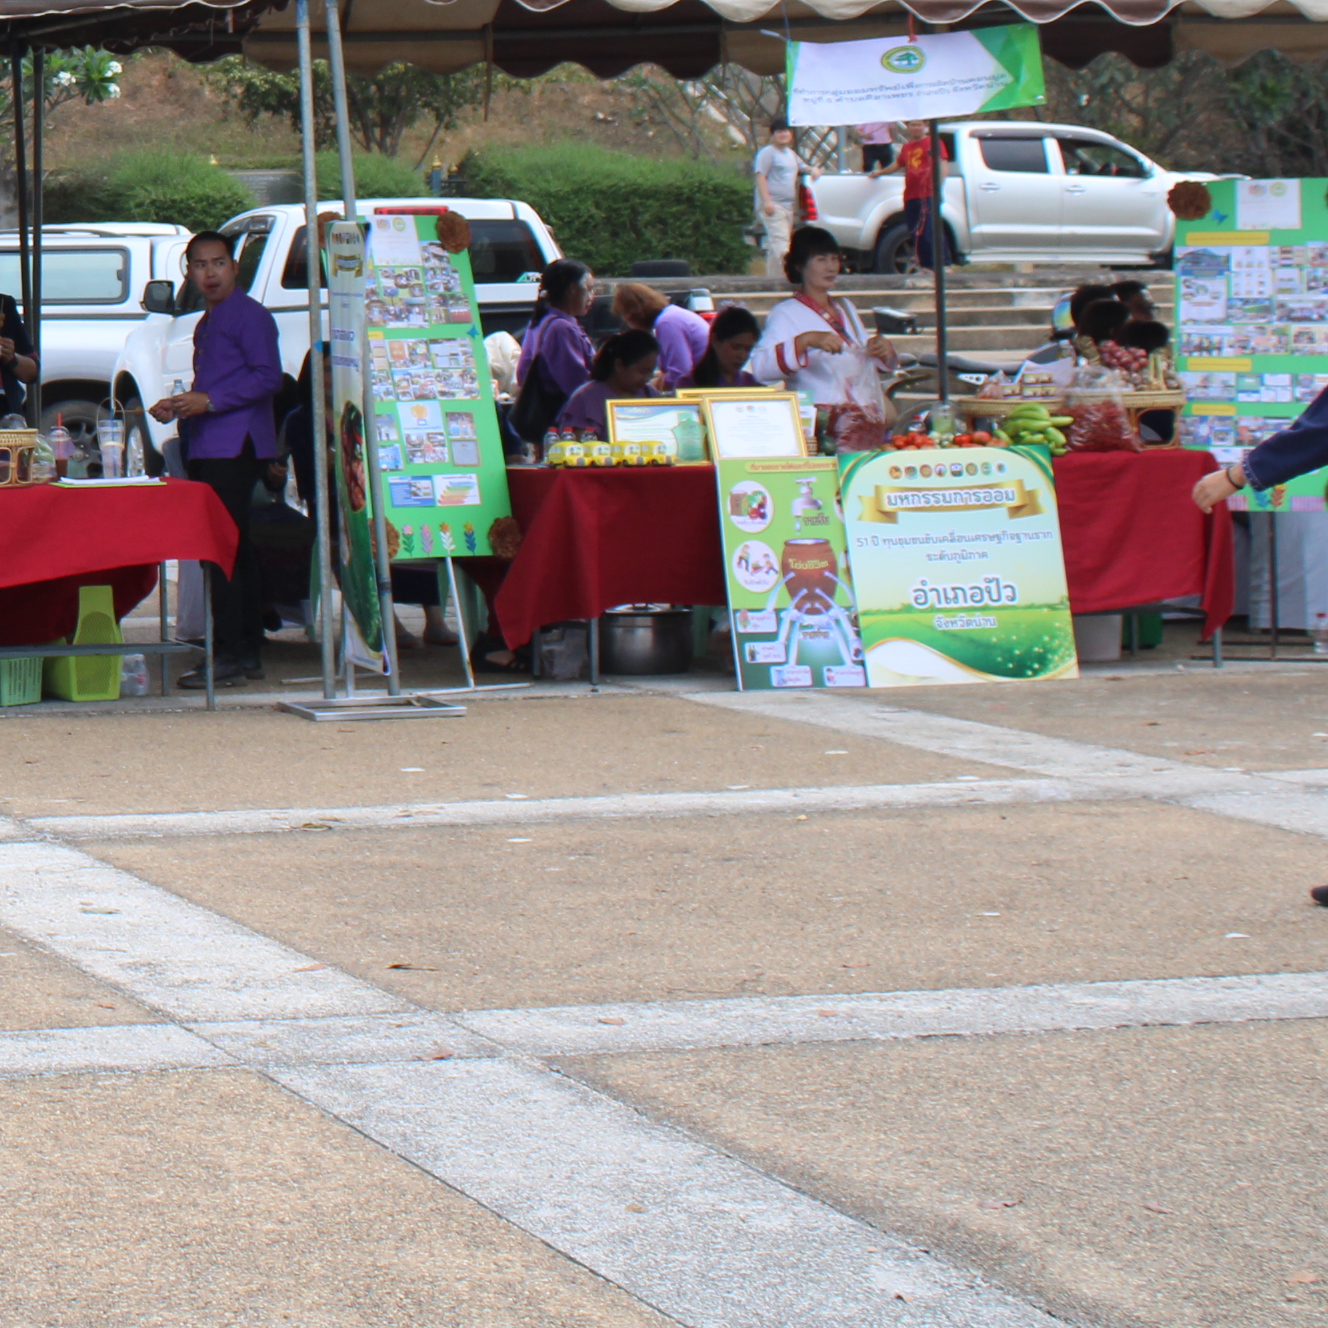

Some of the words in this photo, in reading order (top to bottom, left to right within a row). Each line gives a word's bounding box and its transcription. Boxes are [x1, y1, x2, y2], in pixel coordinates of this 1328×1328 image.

[886, 488, 1016, 507] มหกรรมการออม
[856, 537, 869, 547] 51
[871, 534, 880, 547] ปี
[926, 549, 989, 564] ระดับภูมิภาค
[912, 577, 1018, 607] อำเภอปัว
[935, 615, 997, 629] จังหวัดน่าน
